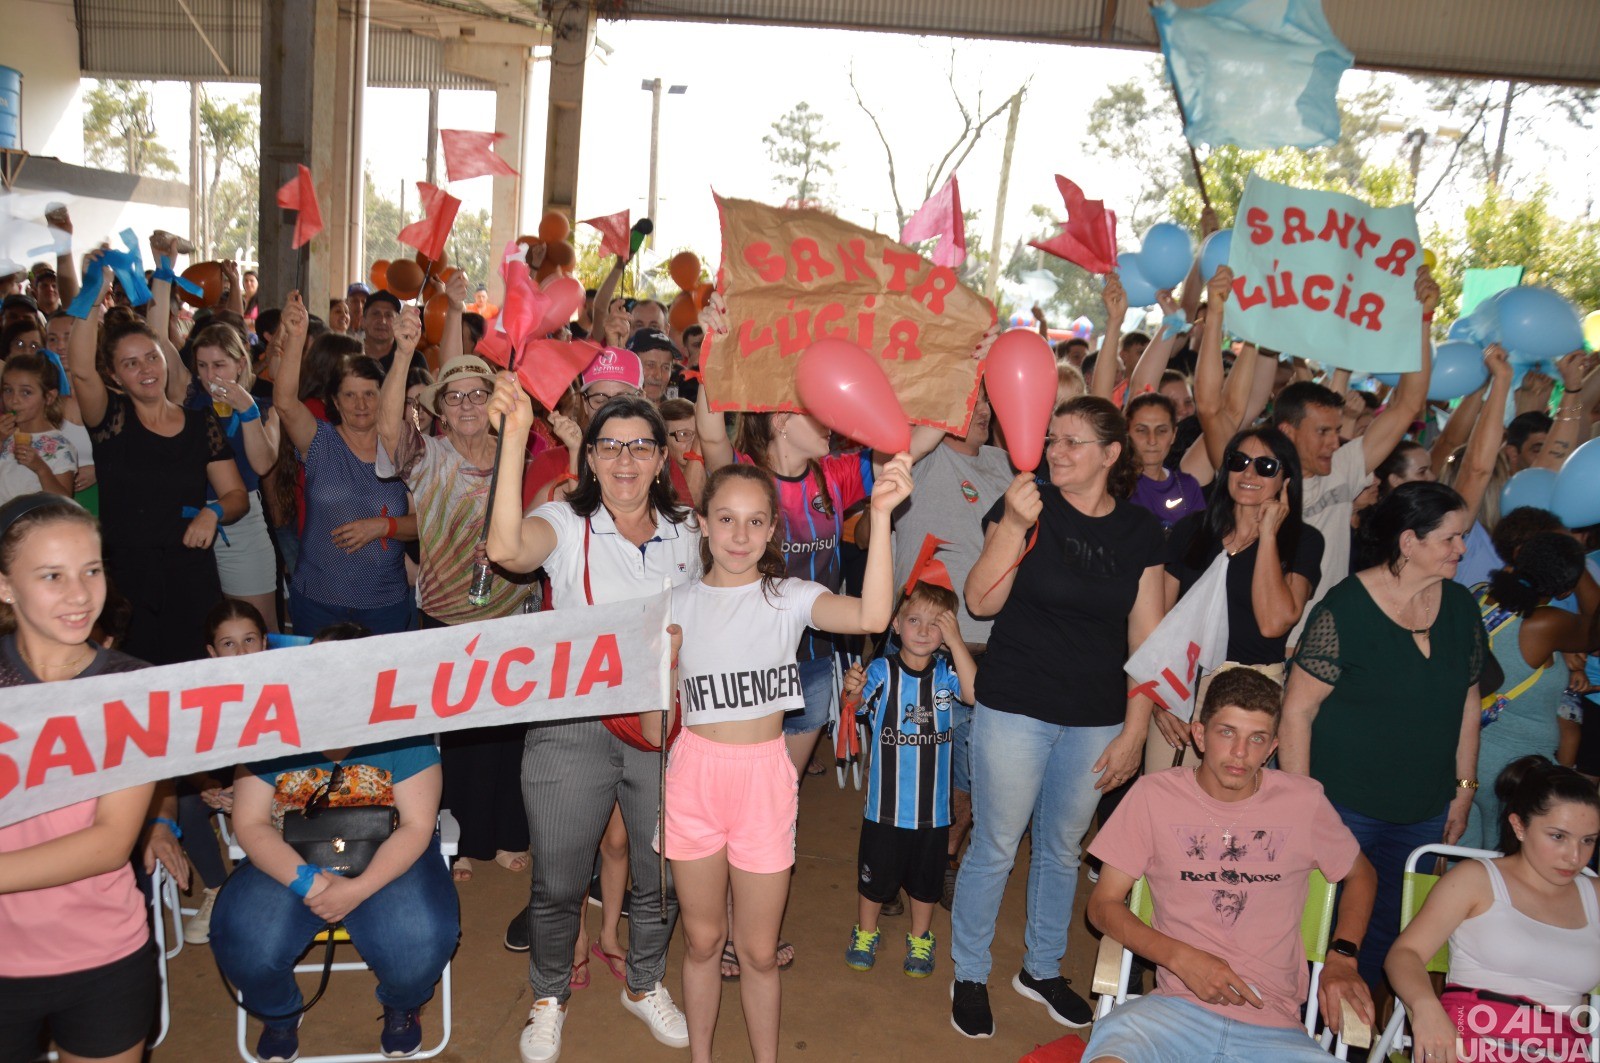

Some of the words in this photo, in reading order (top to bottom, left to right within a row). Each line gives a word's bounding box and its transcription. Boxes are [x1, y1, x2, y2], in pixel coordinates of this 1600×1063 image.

[1246, 207, 1416, 277] SANTA
[743, 237, 957, 316] SANTA
[1232, 259, 1385, 332] LÚCIA
[739, 296, 923, 361] LÚCIA
[781, 534, 836, 553] banrisul
[369, 634, 623, 724] LÚCIA
[684, 663, 801, 713] INFLUENCER
[897, 728, 952, 745] banrisul
[1180, 871, 1218, 882] Red
[1240, 872, 1281, 883] Nose
